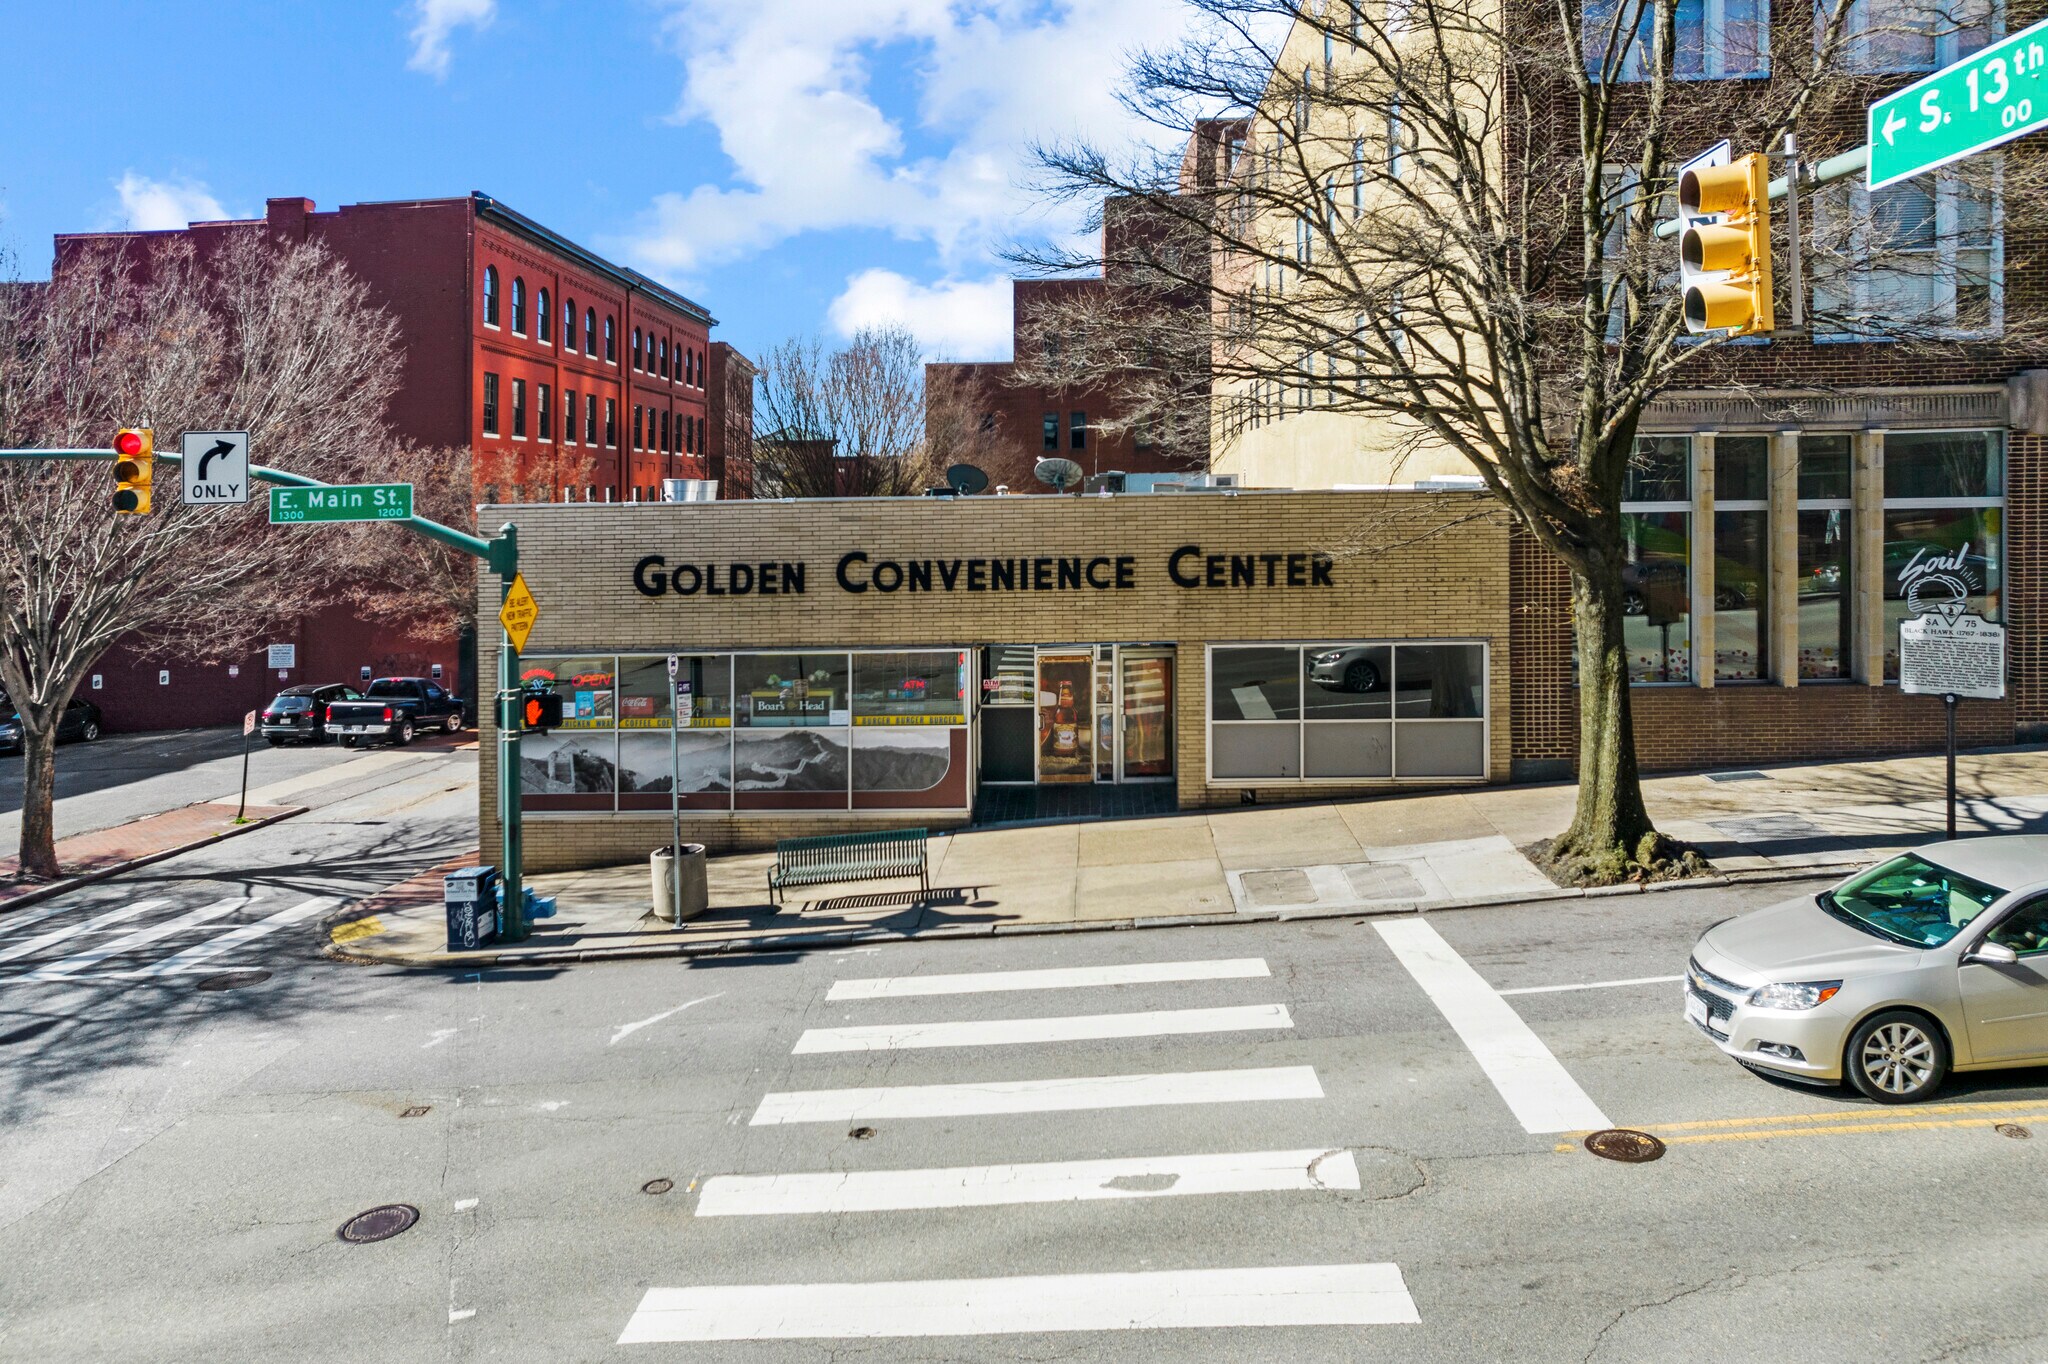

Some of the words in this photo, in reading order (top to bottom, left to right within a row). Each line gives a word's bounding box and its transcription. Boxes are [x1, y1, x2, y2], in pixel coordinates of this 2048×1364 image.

[1919, 89, 1951, 133] S.
[1966, 42, 2045, 112] 13th
[2001, 98, 2032, 128] 00
[192, 484, 239, 498] ONLY
[279, 492, 298, 508] E.
[308, 491, 362, 508] Main
[373, 489, 402, 505] St.
[279, 511, 304, 520] 1300
[379, 507, 403, 517] 1200
[633, 555, 805, 596] GOLDEN
[836, 551, 1135, 593] CONVENIENCE
[1168, 545, 1333, 589] CENTER
[1925, 619, 1939, 627] SA
[1965, 620, 1977, 628] 75
[1904, 627, 1928, 635] BLACK
[1931, 628, 1954, 636] HAWK
[571, 673, 611, 687] OPEN
[903, 680, 925, 689] ATM
[758, 700, 785, 711] Boar's
[799, 700, 824, 711] Head
[625, 719, 651, 727] COFFEE
[896, 717, 924, 725] BURGER
[930, 716, 957, 724] BURGER
